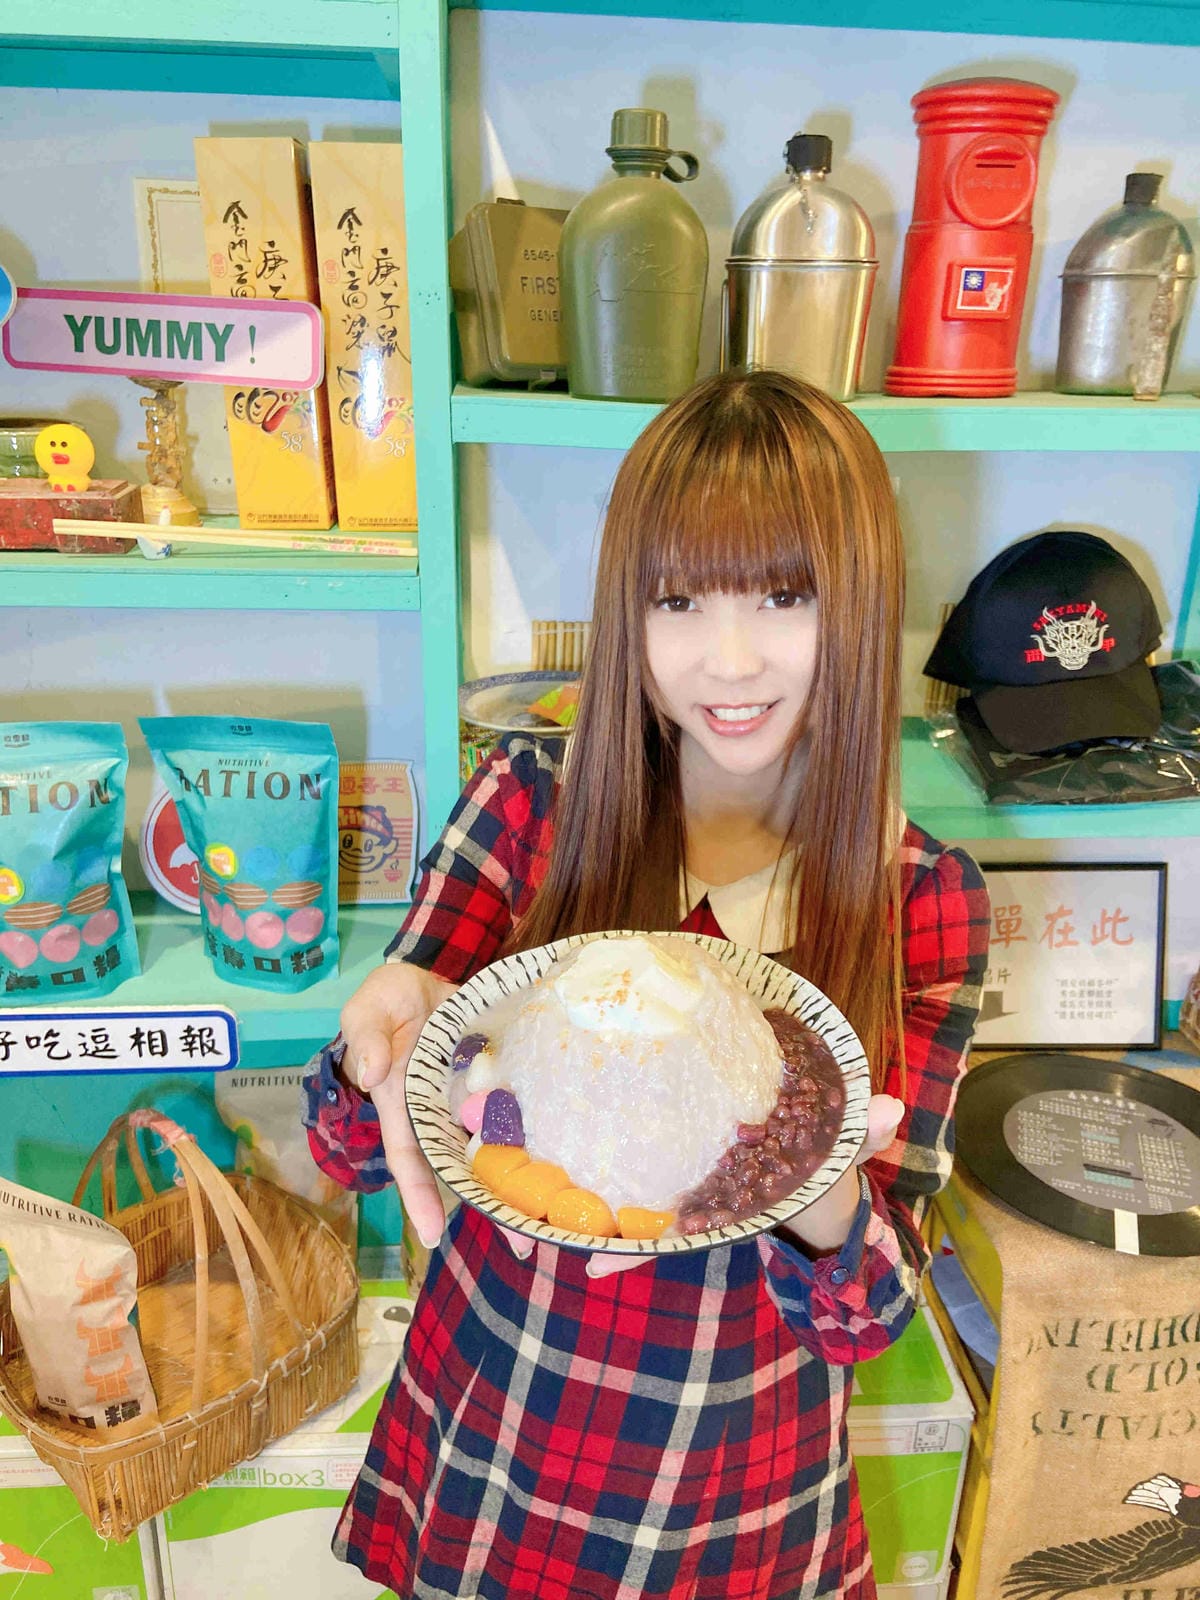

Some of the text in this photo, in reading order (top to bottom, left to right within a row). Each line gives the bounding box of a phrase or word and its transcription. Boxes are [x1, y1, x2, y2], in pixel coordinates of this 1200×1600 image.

[520, 276, 560, 295] FIRS
[63, 313, 257, 364] YUMMY !
[217, 757, 272, 768] NUTRITIVE
[989, 904, 1135, 950] 單在此
[1086, 1357, 1200, 1394] OLD
[263, 1467, 326, 1487] box3
